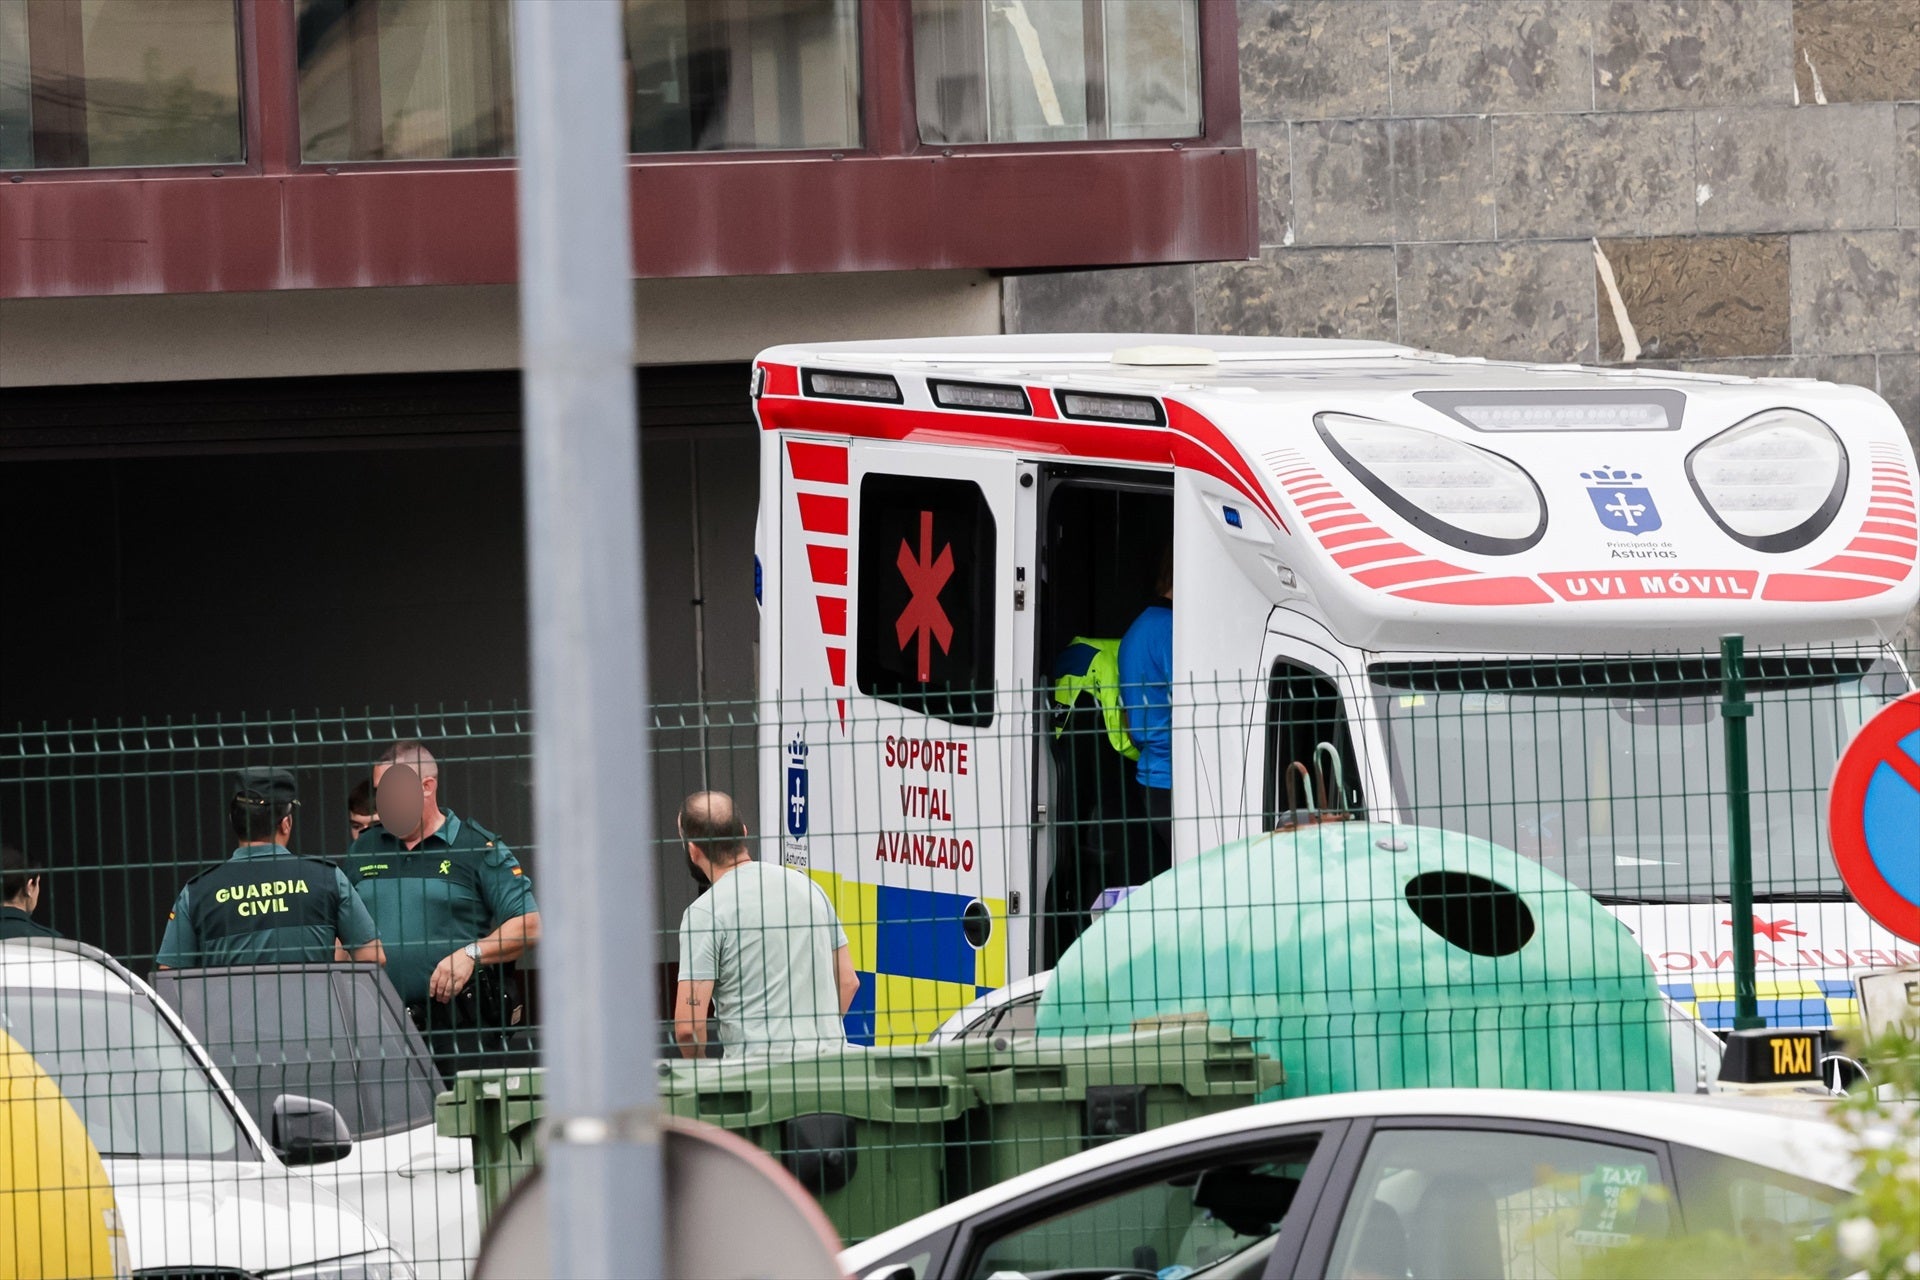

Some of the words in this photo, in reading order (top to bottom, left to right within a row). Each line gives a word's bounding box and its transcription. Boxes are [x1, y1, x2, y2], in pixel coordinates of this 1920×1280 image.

[1606, 541, 1659, 550] Principado
[1660, 541, 1673, 549] de
[1611, 548, 1678, 559] Asturias
[1565, 577, 1627, 596] UVI
[1639, 572, 1749, 595] MÓVIL
[885, 735, 968, 775] SOPORTE
[900, 785, 951, 821] VITAL
[876, 830, 974, 872] AVANZADO
[215, 880, 309, 903] GUARDIA
[238, 898, 289, 917] CIVIL
[1769, 1037, 1812, 1075] TAXI
[1602, 1166, 1642, 1186] TAXI
